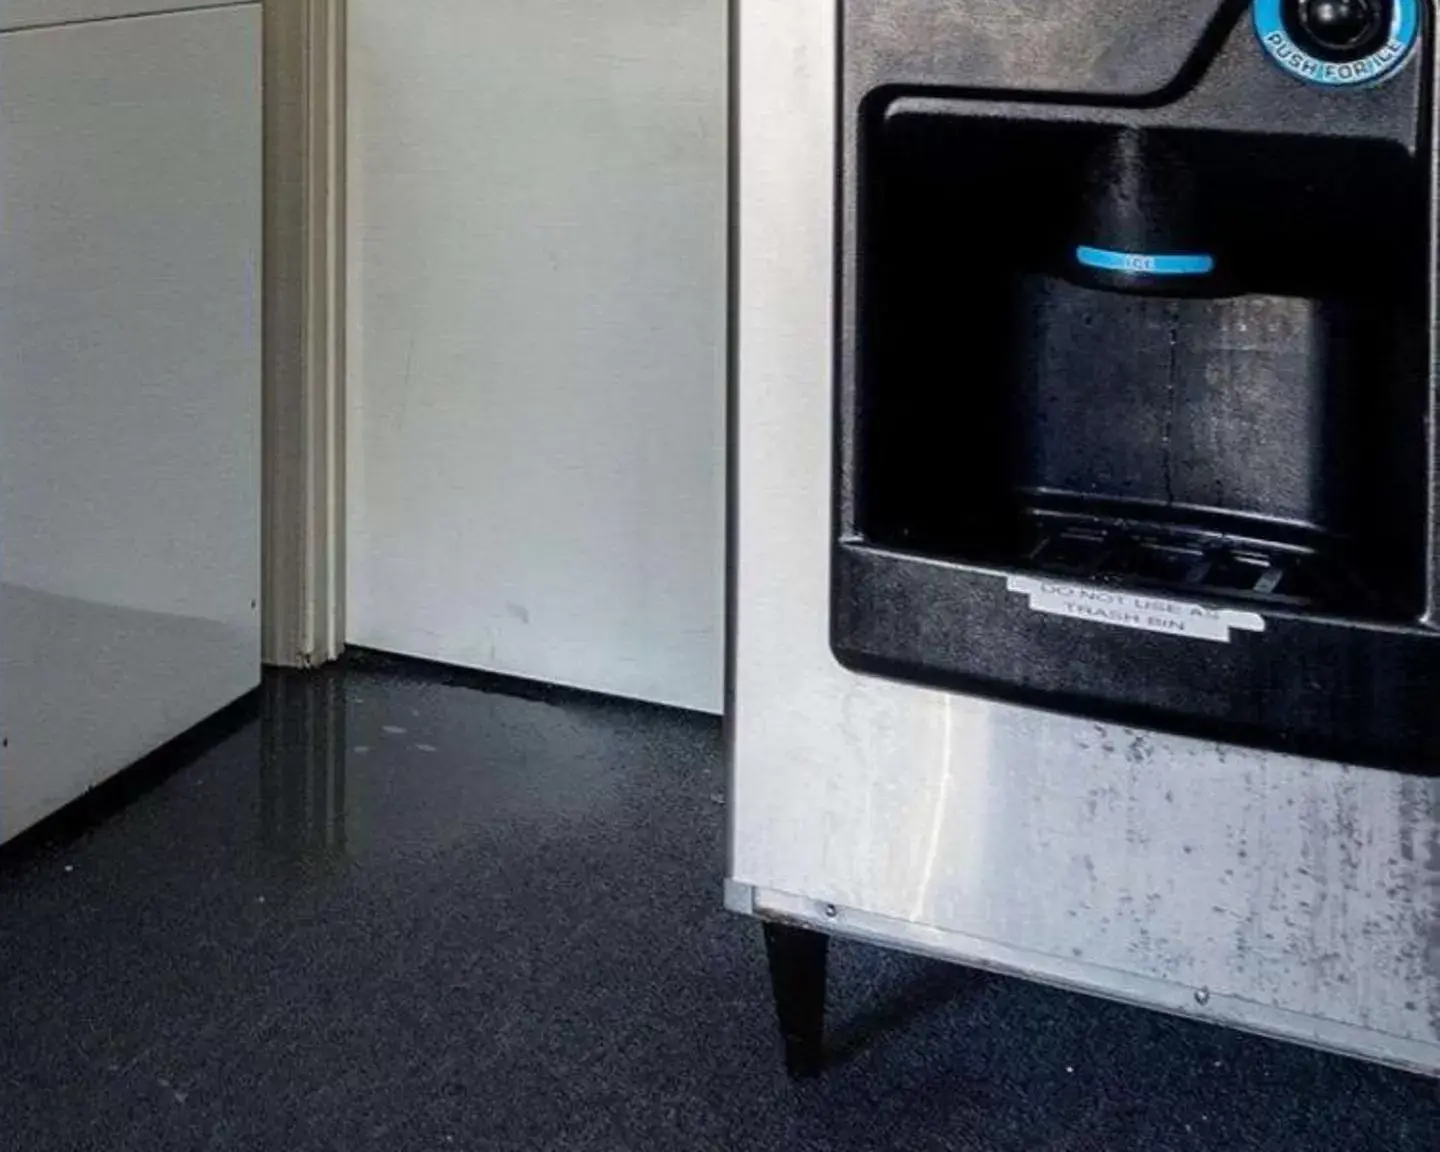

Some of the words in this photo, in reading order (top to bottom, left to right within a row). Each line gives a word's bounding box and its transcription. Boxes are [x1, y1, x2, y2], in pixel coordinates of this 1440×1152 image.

[1268, 32, 1318, 76] PUSH
[1324, 61, 1368, 80] FOR
[1040, 582, 1075, 599] DO
[1079, 587, 1127, 606] NOT
[1133, 599, 1184, 614] USE
[1064, 601, 1140, 625] TRASH
[1148, 616, 1187, 632] BIN
